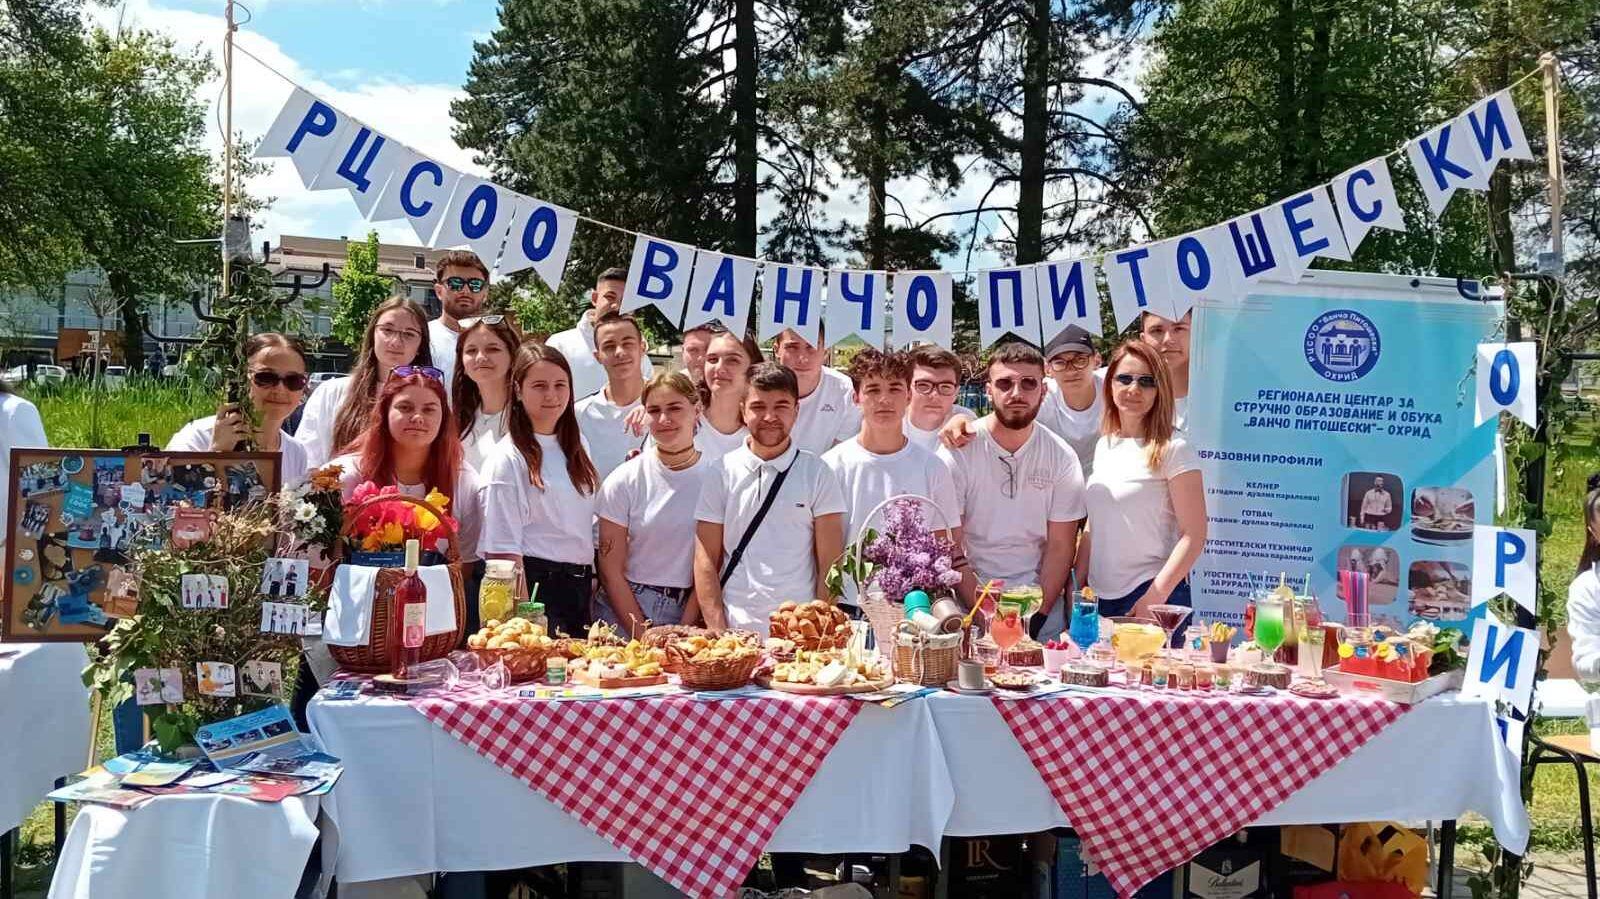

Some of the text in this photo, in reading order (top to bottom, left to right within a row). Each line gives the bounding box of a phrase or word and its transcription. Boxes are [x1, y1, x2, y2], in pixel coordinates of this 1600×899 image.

[286, 98, 1514, 332] РЦСОО ВАНЧО ПИТОШЕСКИ
[1257, 389, 1415, 409] РЕГИОНАЛЕН ЦЕНТАР ЗА
[1234, 401, 1443, 424] СТРУЧНО ОБРАЗОВАНИЕ И ОБУКА
[1387, 424, 1432, 439] ОХРИД
[1198, 450, 1323, 467] БРАЗОВНИ ПРОФИЛИ
[1246, 481, 1280, 490] КЕЛНЕР
[1241, 509, 1273, 518] ГОТВАЧ
[1267, 543, 1313, 554] ТЕХНИЧАР
